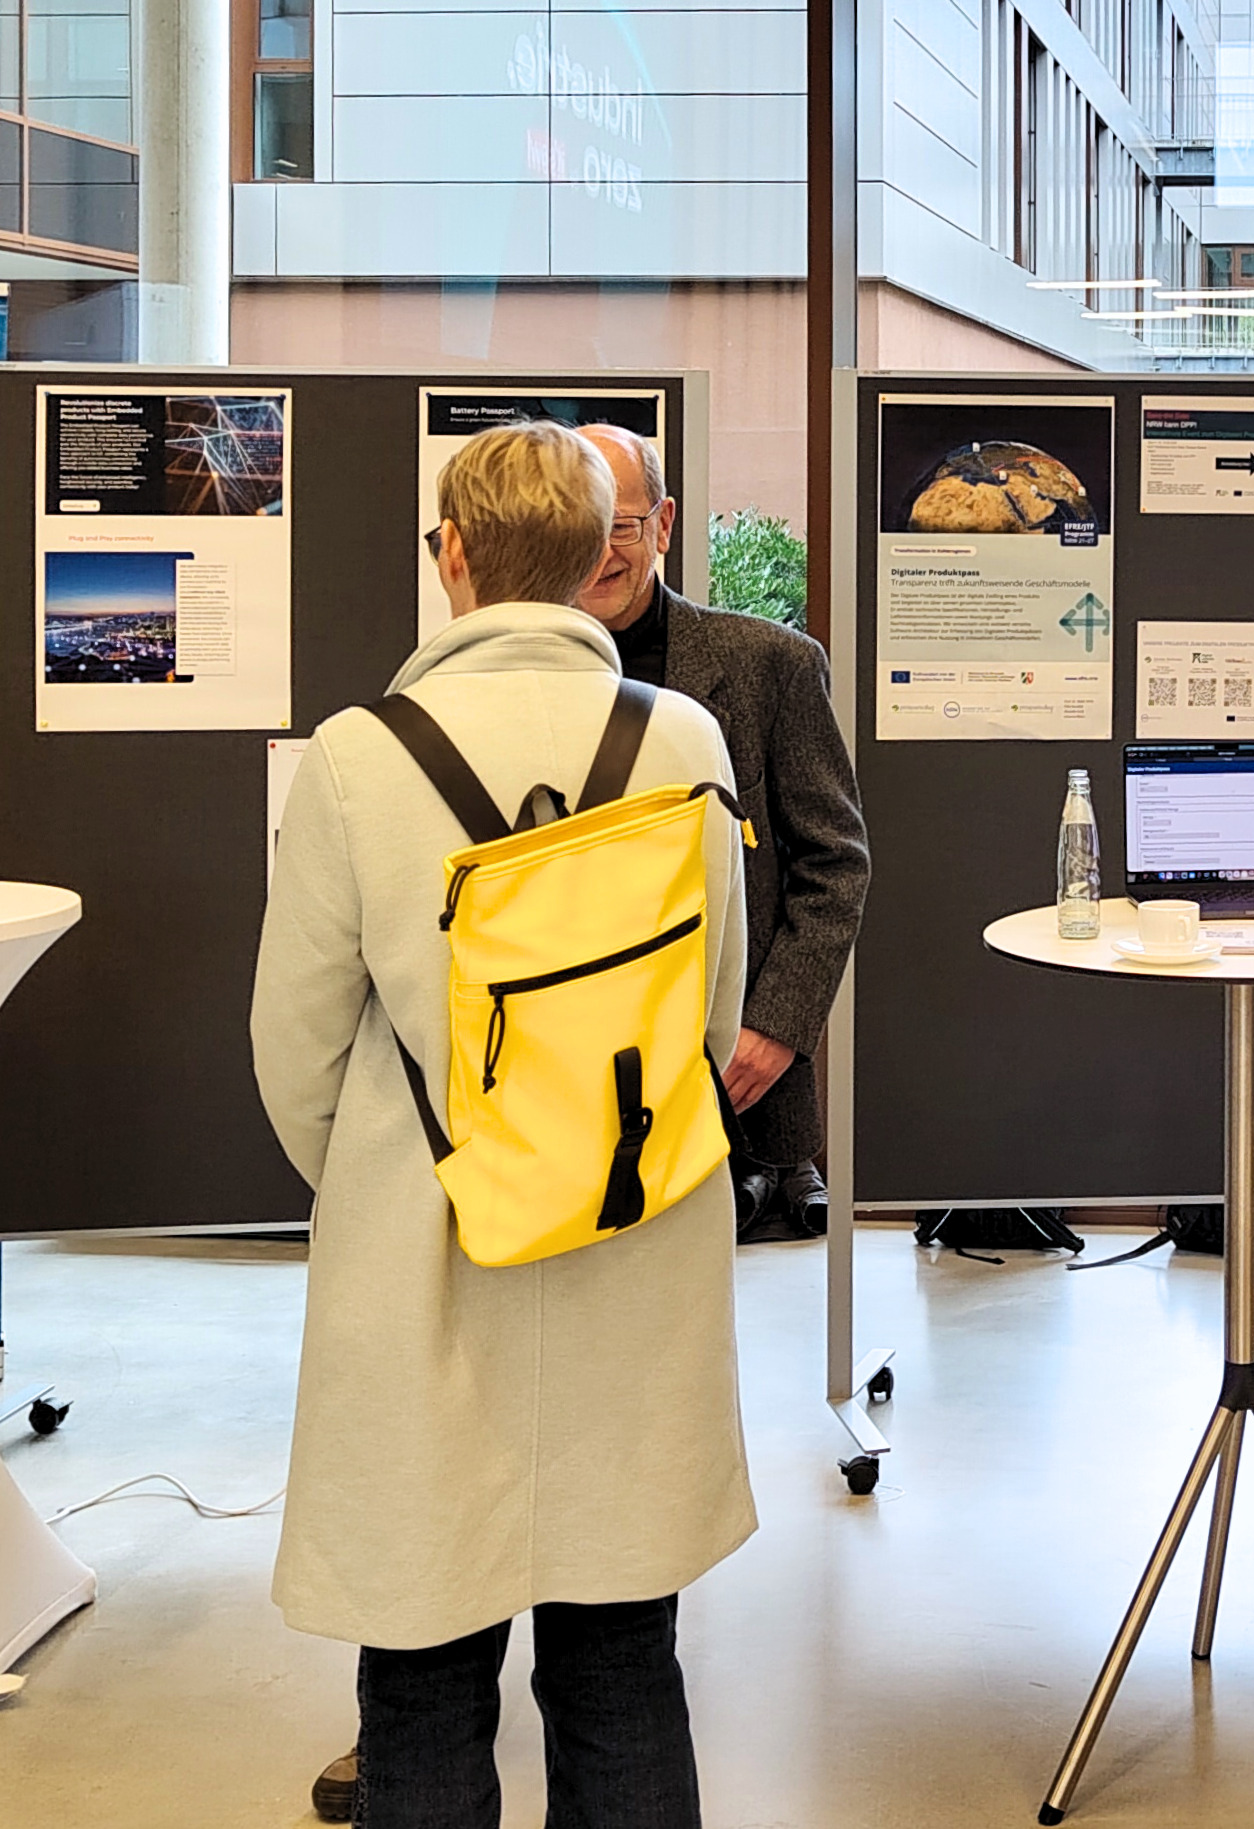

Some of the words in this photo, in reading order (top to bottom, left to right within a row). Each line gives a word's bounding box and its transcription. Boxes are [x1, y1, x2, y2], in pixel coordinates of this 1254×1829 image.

[450, 407, 480, 416] Battery
[481, 406, 515, 415] Passport
[891, 568, 926, 577] Digitaler
[928, 568, 980, 577] Produktpass
[891, 579, 937, 587] Transparenz
[1025, 579, 1091, 587] Geschäftsmodelle
